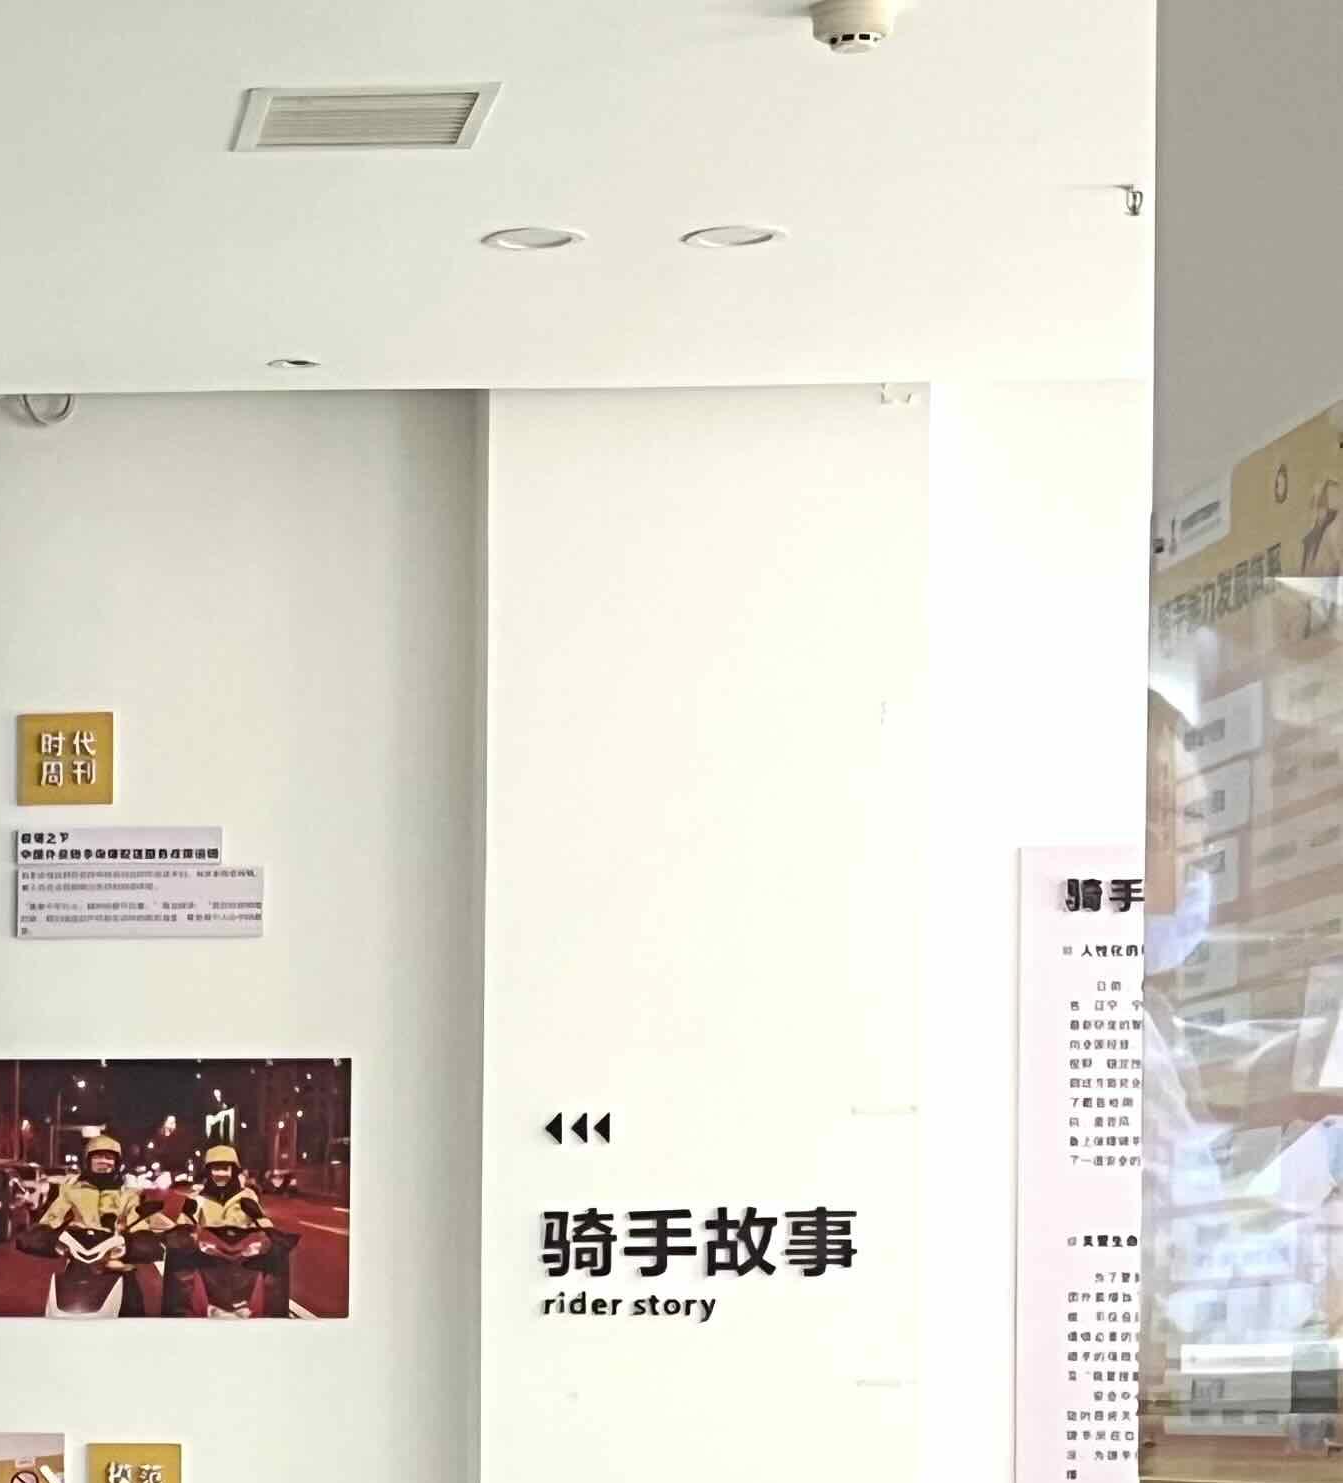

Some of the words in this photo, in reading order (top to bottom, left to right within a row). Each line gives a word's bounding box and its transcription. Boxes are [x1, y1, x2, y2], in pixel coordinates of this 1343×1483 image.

[39, 730, 98, 757] 时代
[39, 758, 98, 787] 周刊
[541, 1206, 858, 1278] 骑手故事
[542, 1291, 623, 1317] rider
[632, 1294, 717, 1324] story
